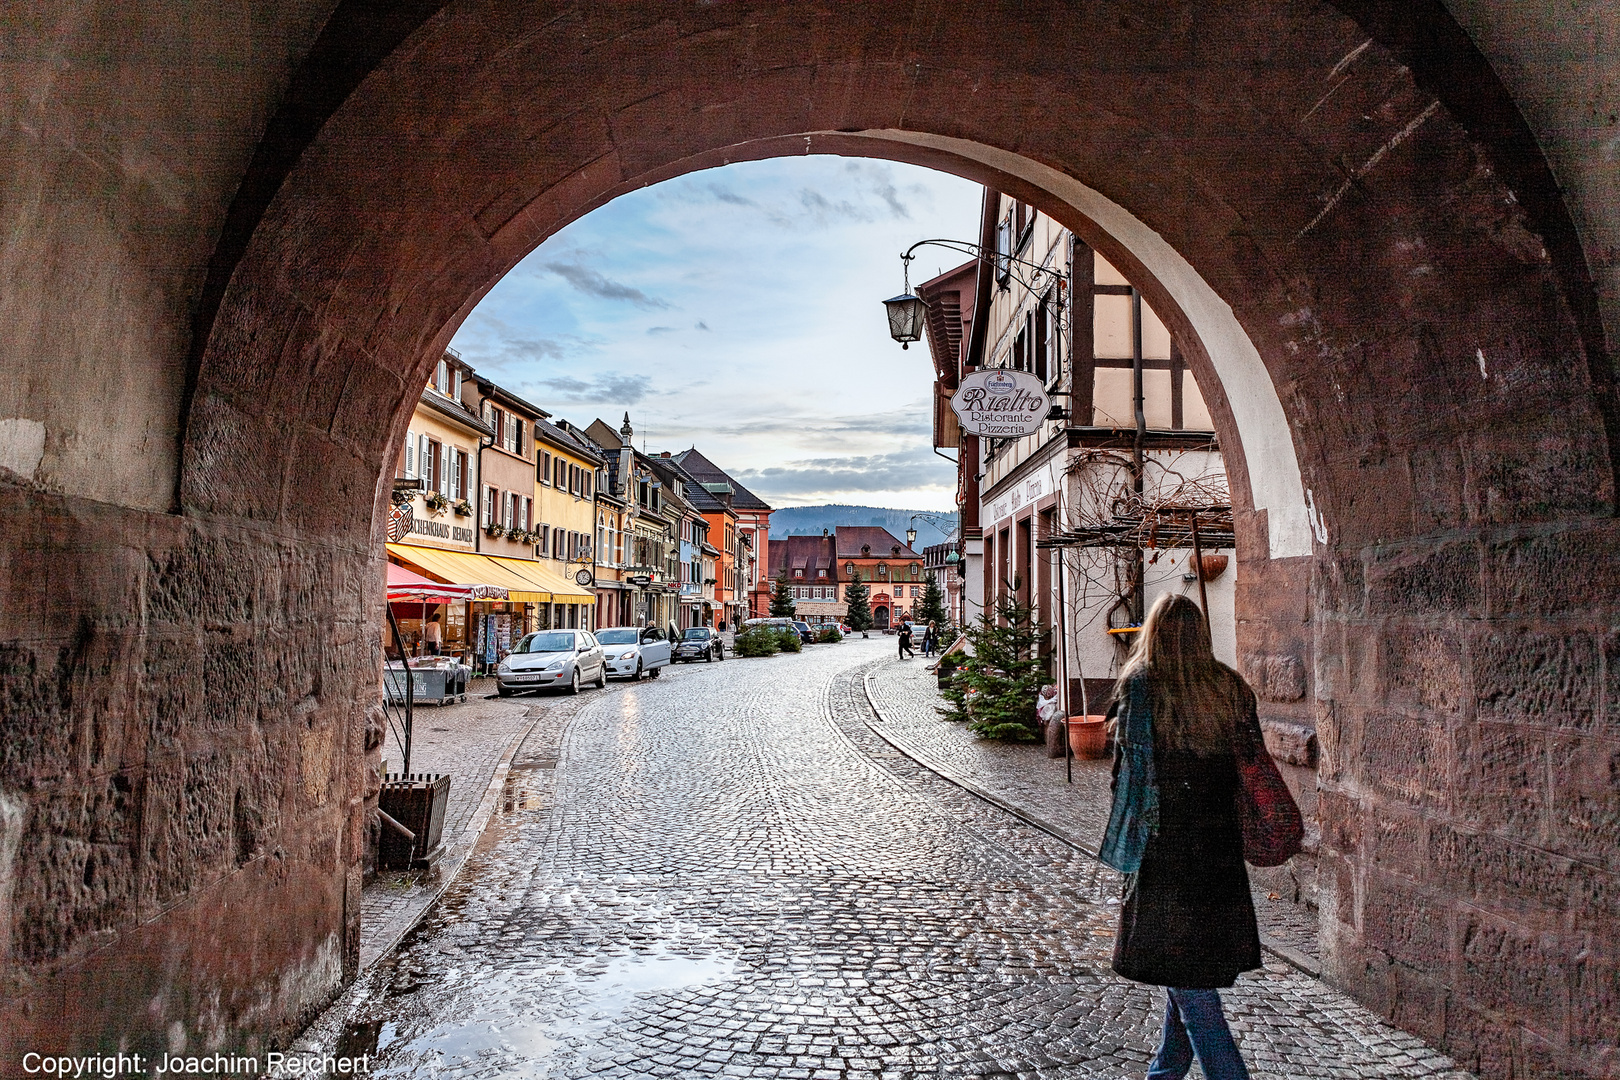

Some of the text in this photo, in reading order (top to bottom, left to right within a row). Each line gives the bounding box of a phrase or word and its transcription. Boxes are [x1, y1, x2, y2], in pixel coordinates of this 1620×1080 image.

[960, 386, 1043, 412] Rialto
[971, 411, 1033, 423] Ristorante
[978, 422, 1025, 434] Pizzeria
